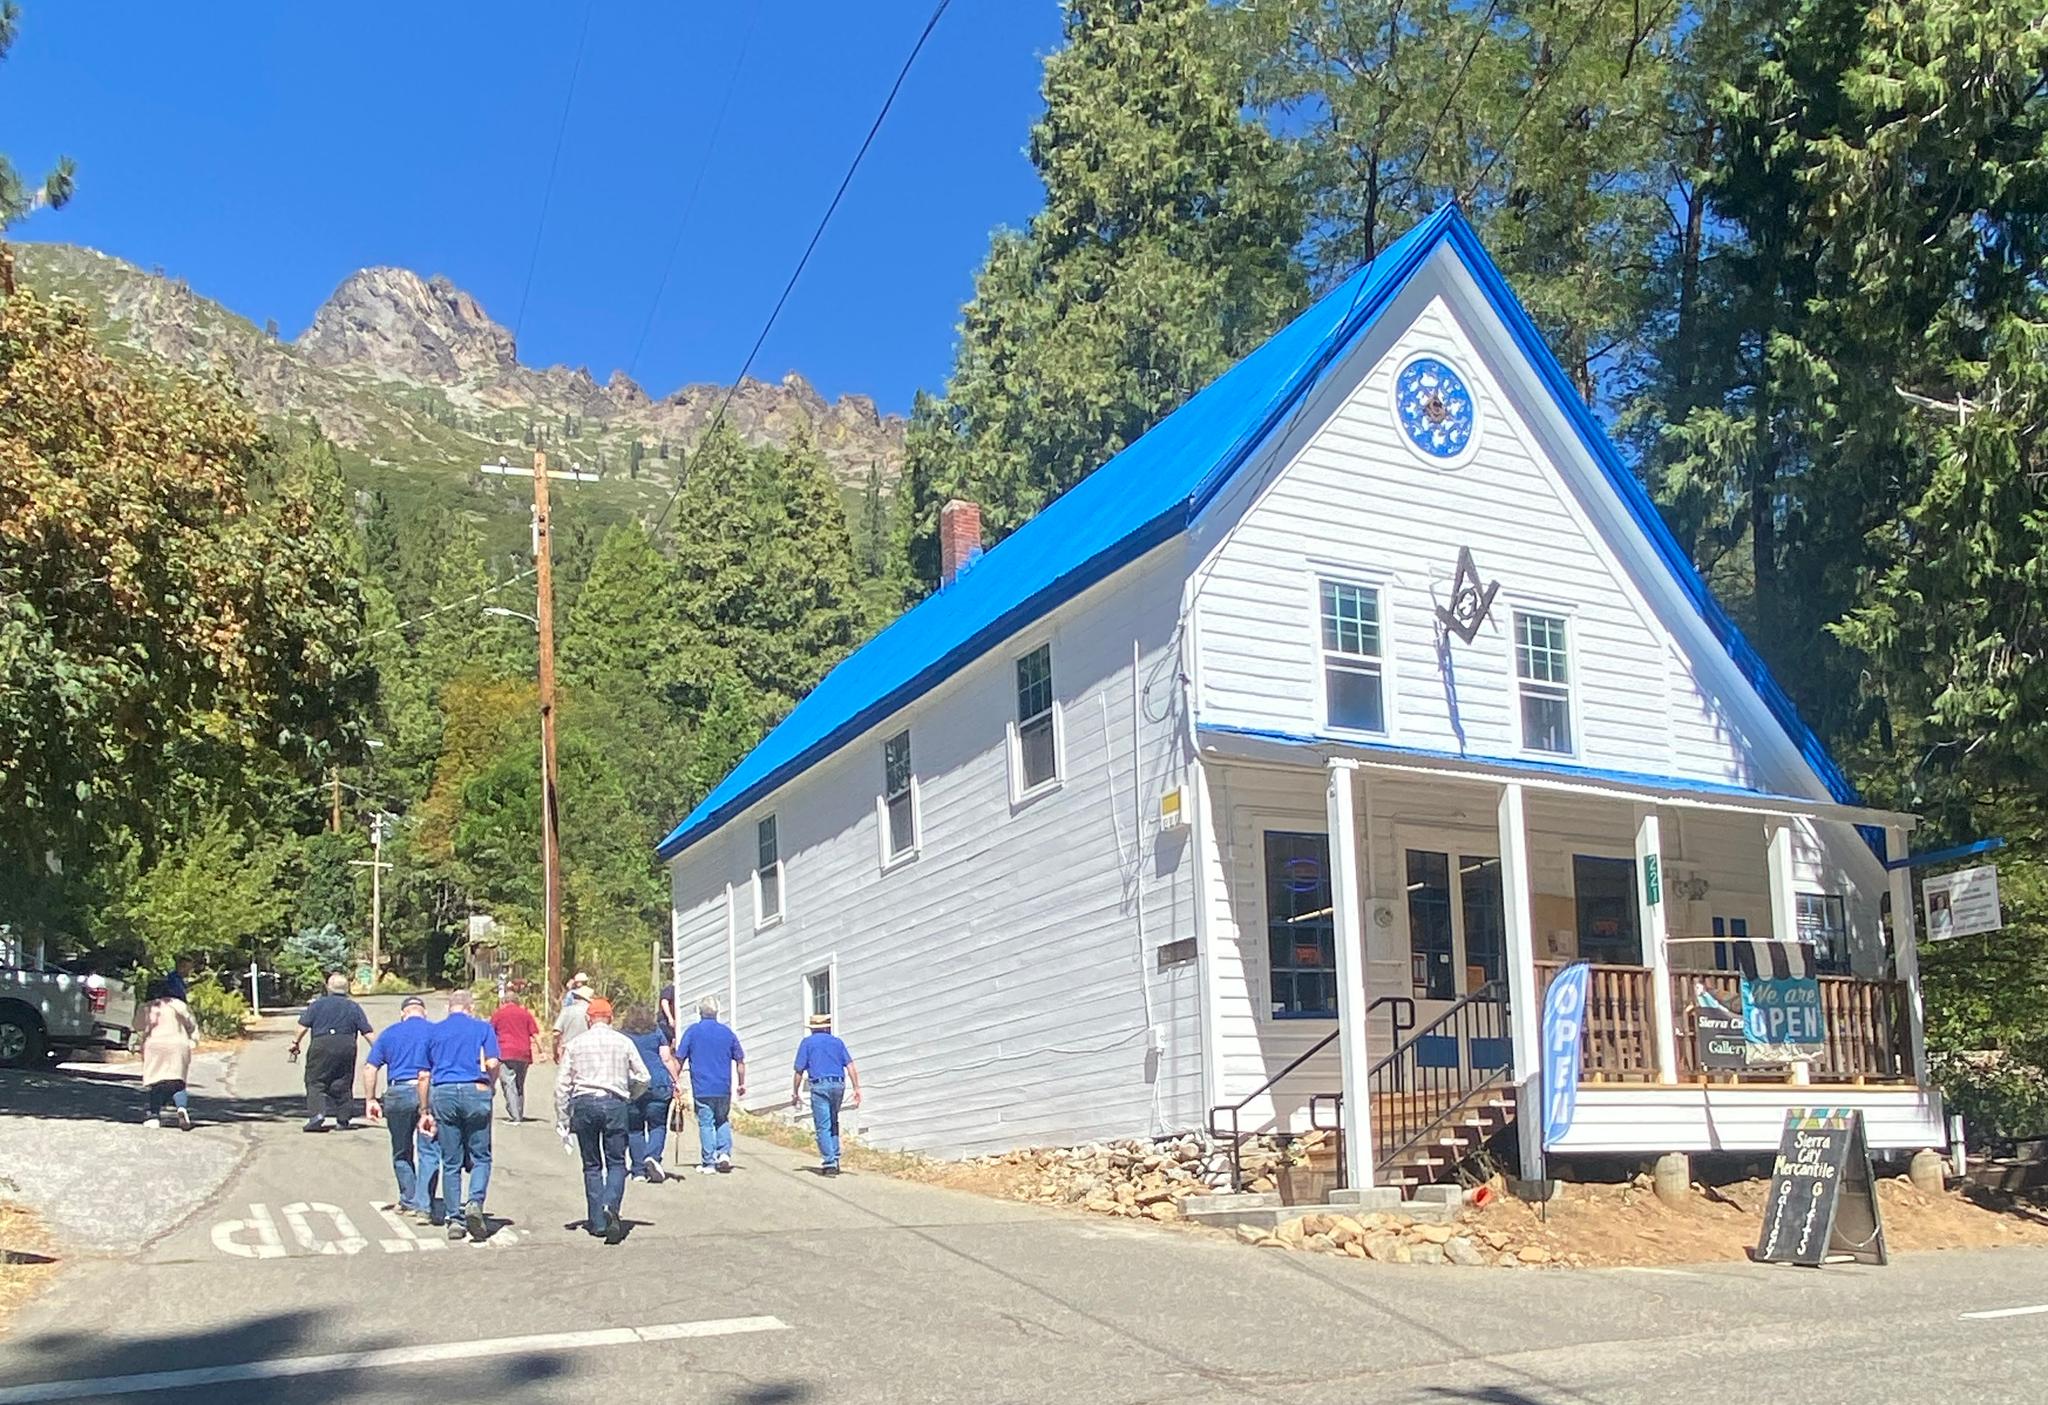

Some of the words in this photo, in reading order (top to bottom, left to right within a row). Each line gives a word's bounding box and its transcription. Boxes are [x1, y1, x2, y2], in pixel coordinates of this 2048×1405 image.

[1648, 856, 1658, 902] 221
[1751, 984, 1778, 1003] We
[1785, 987, 1816, 1004] are
[1698, 1016, 1728, 1028] Sierra
[1750, 1006, 1817, 1038] OPEN
[1551, 983, 1579, 1124] OPEN
[1708, 1040, 1746, 1058] Gallery
[1794, 1131, 1831, 1148] Sierra
[1773, 1154, 1835, 1178] Mercantile
[1798, 1148, 1822, 1164] City
